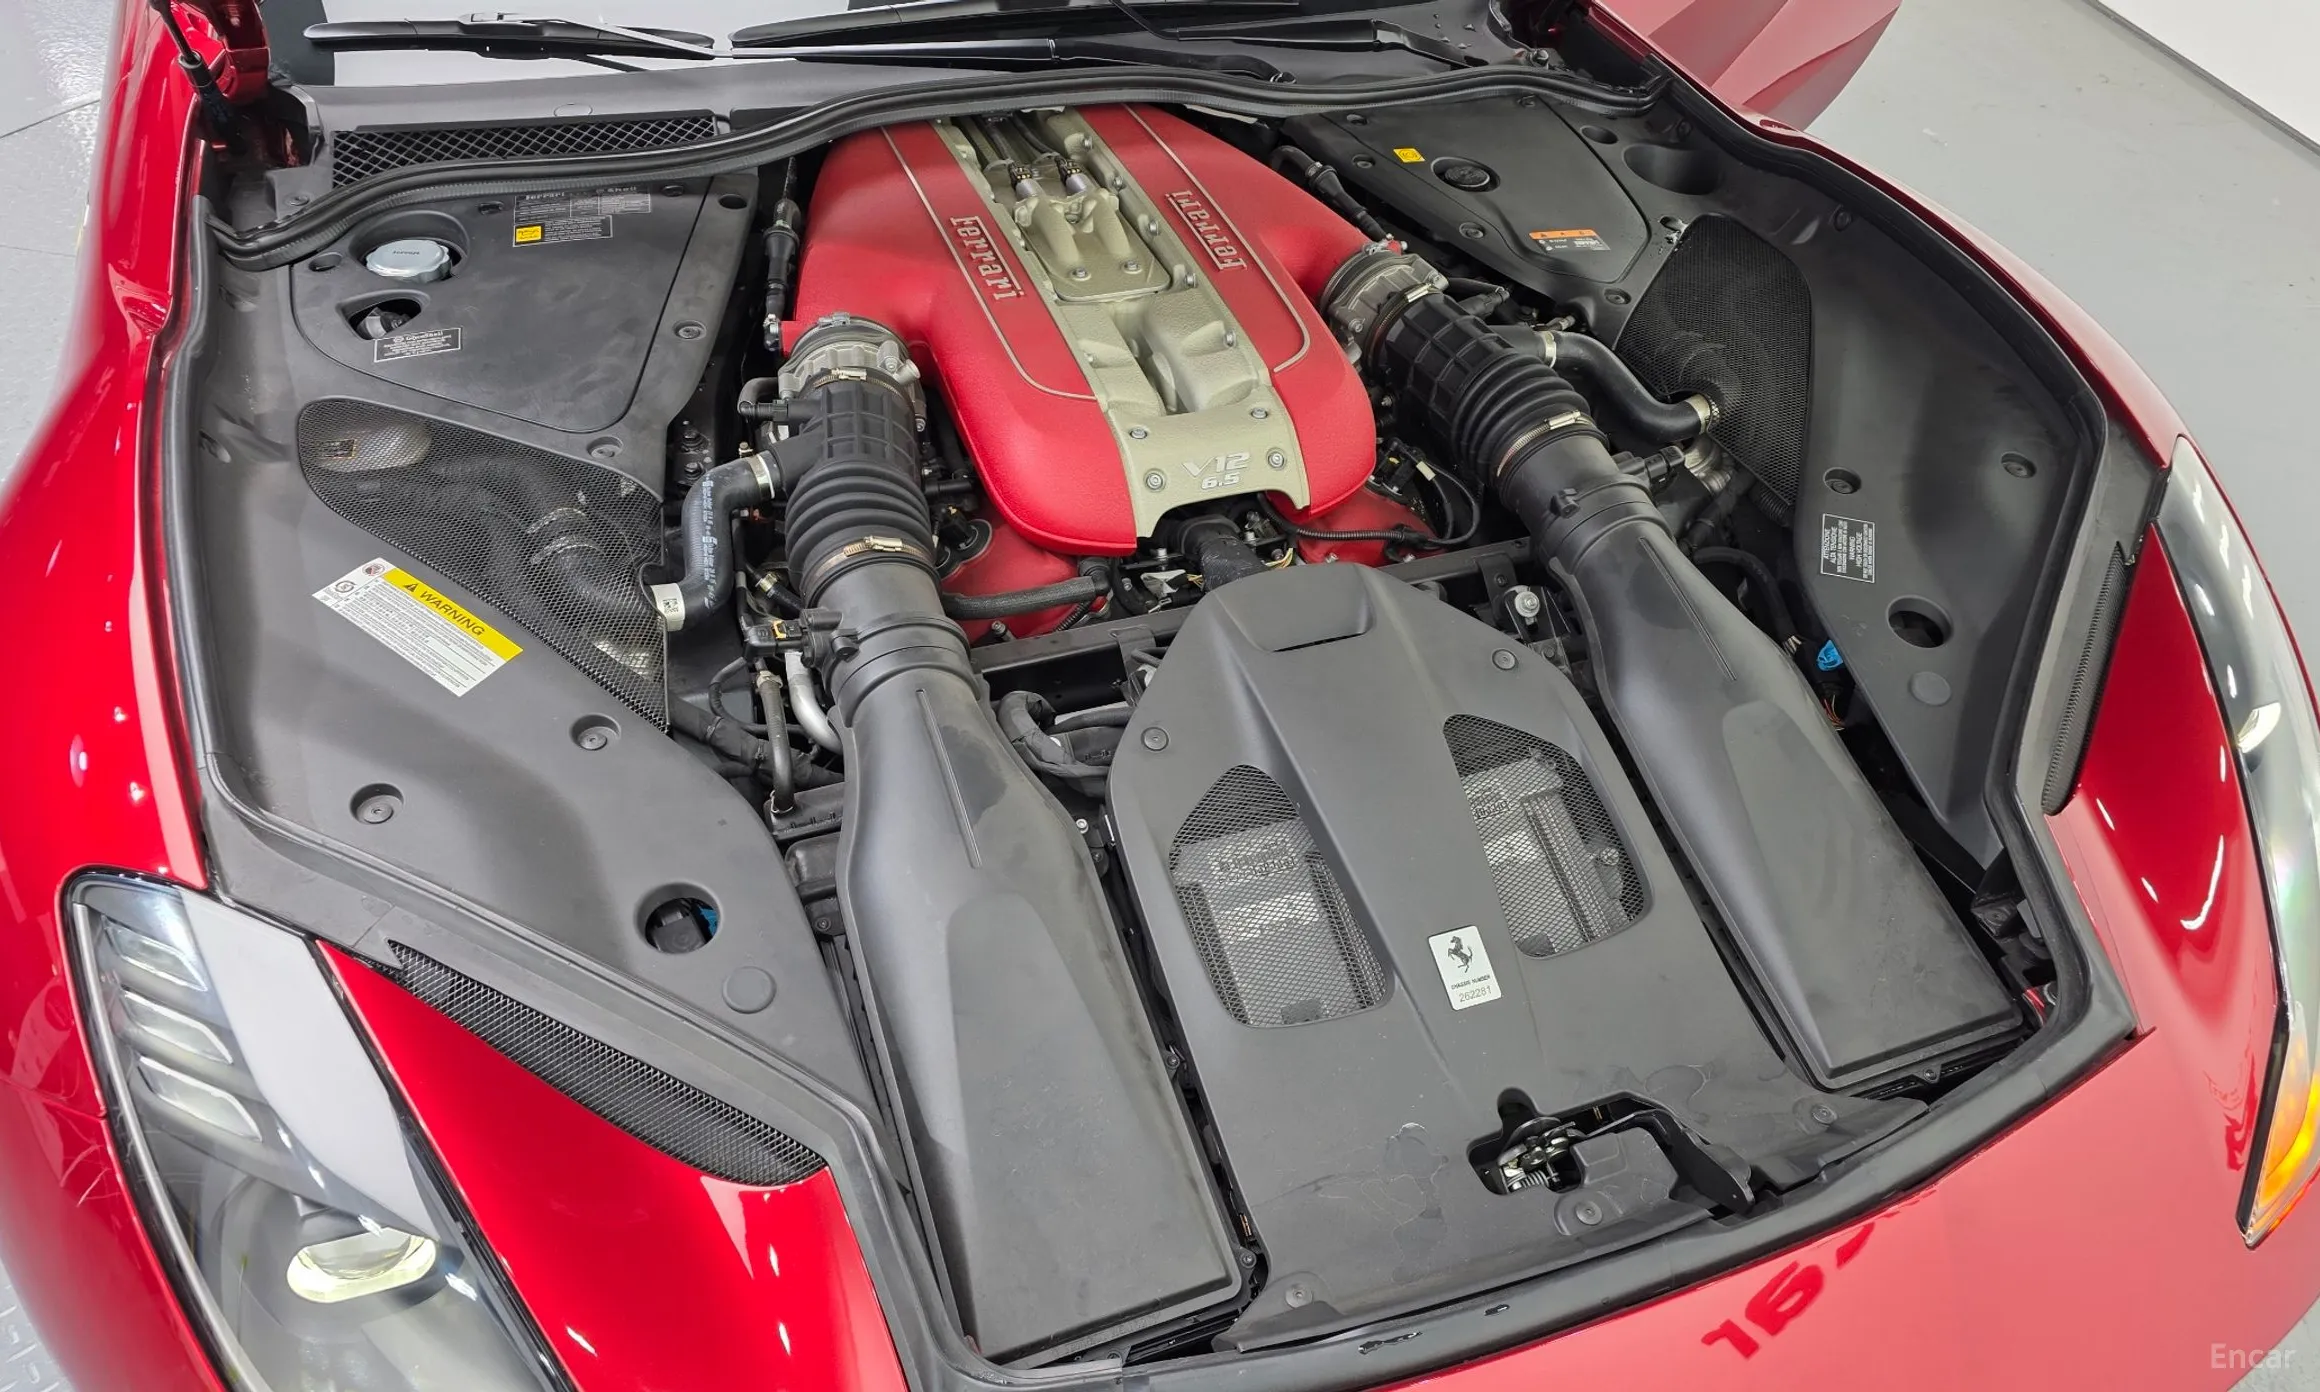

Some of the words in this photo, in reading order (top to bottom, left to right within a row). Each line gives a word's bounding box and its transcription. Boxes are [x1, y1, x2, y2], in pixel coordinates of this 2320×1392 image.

[1165, 190, 1248, 271] Ferrari
[950, 215, 1025, 301] Ferrari
[1182, 451, 1251, 478] V12
[1201, 471, 1241, 490] 6.5
[420, 590, 485, 637] WARNING
[1459, 985, 1492, 1002] 262281
